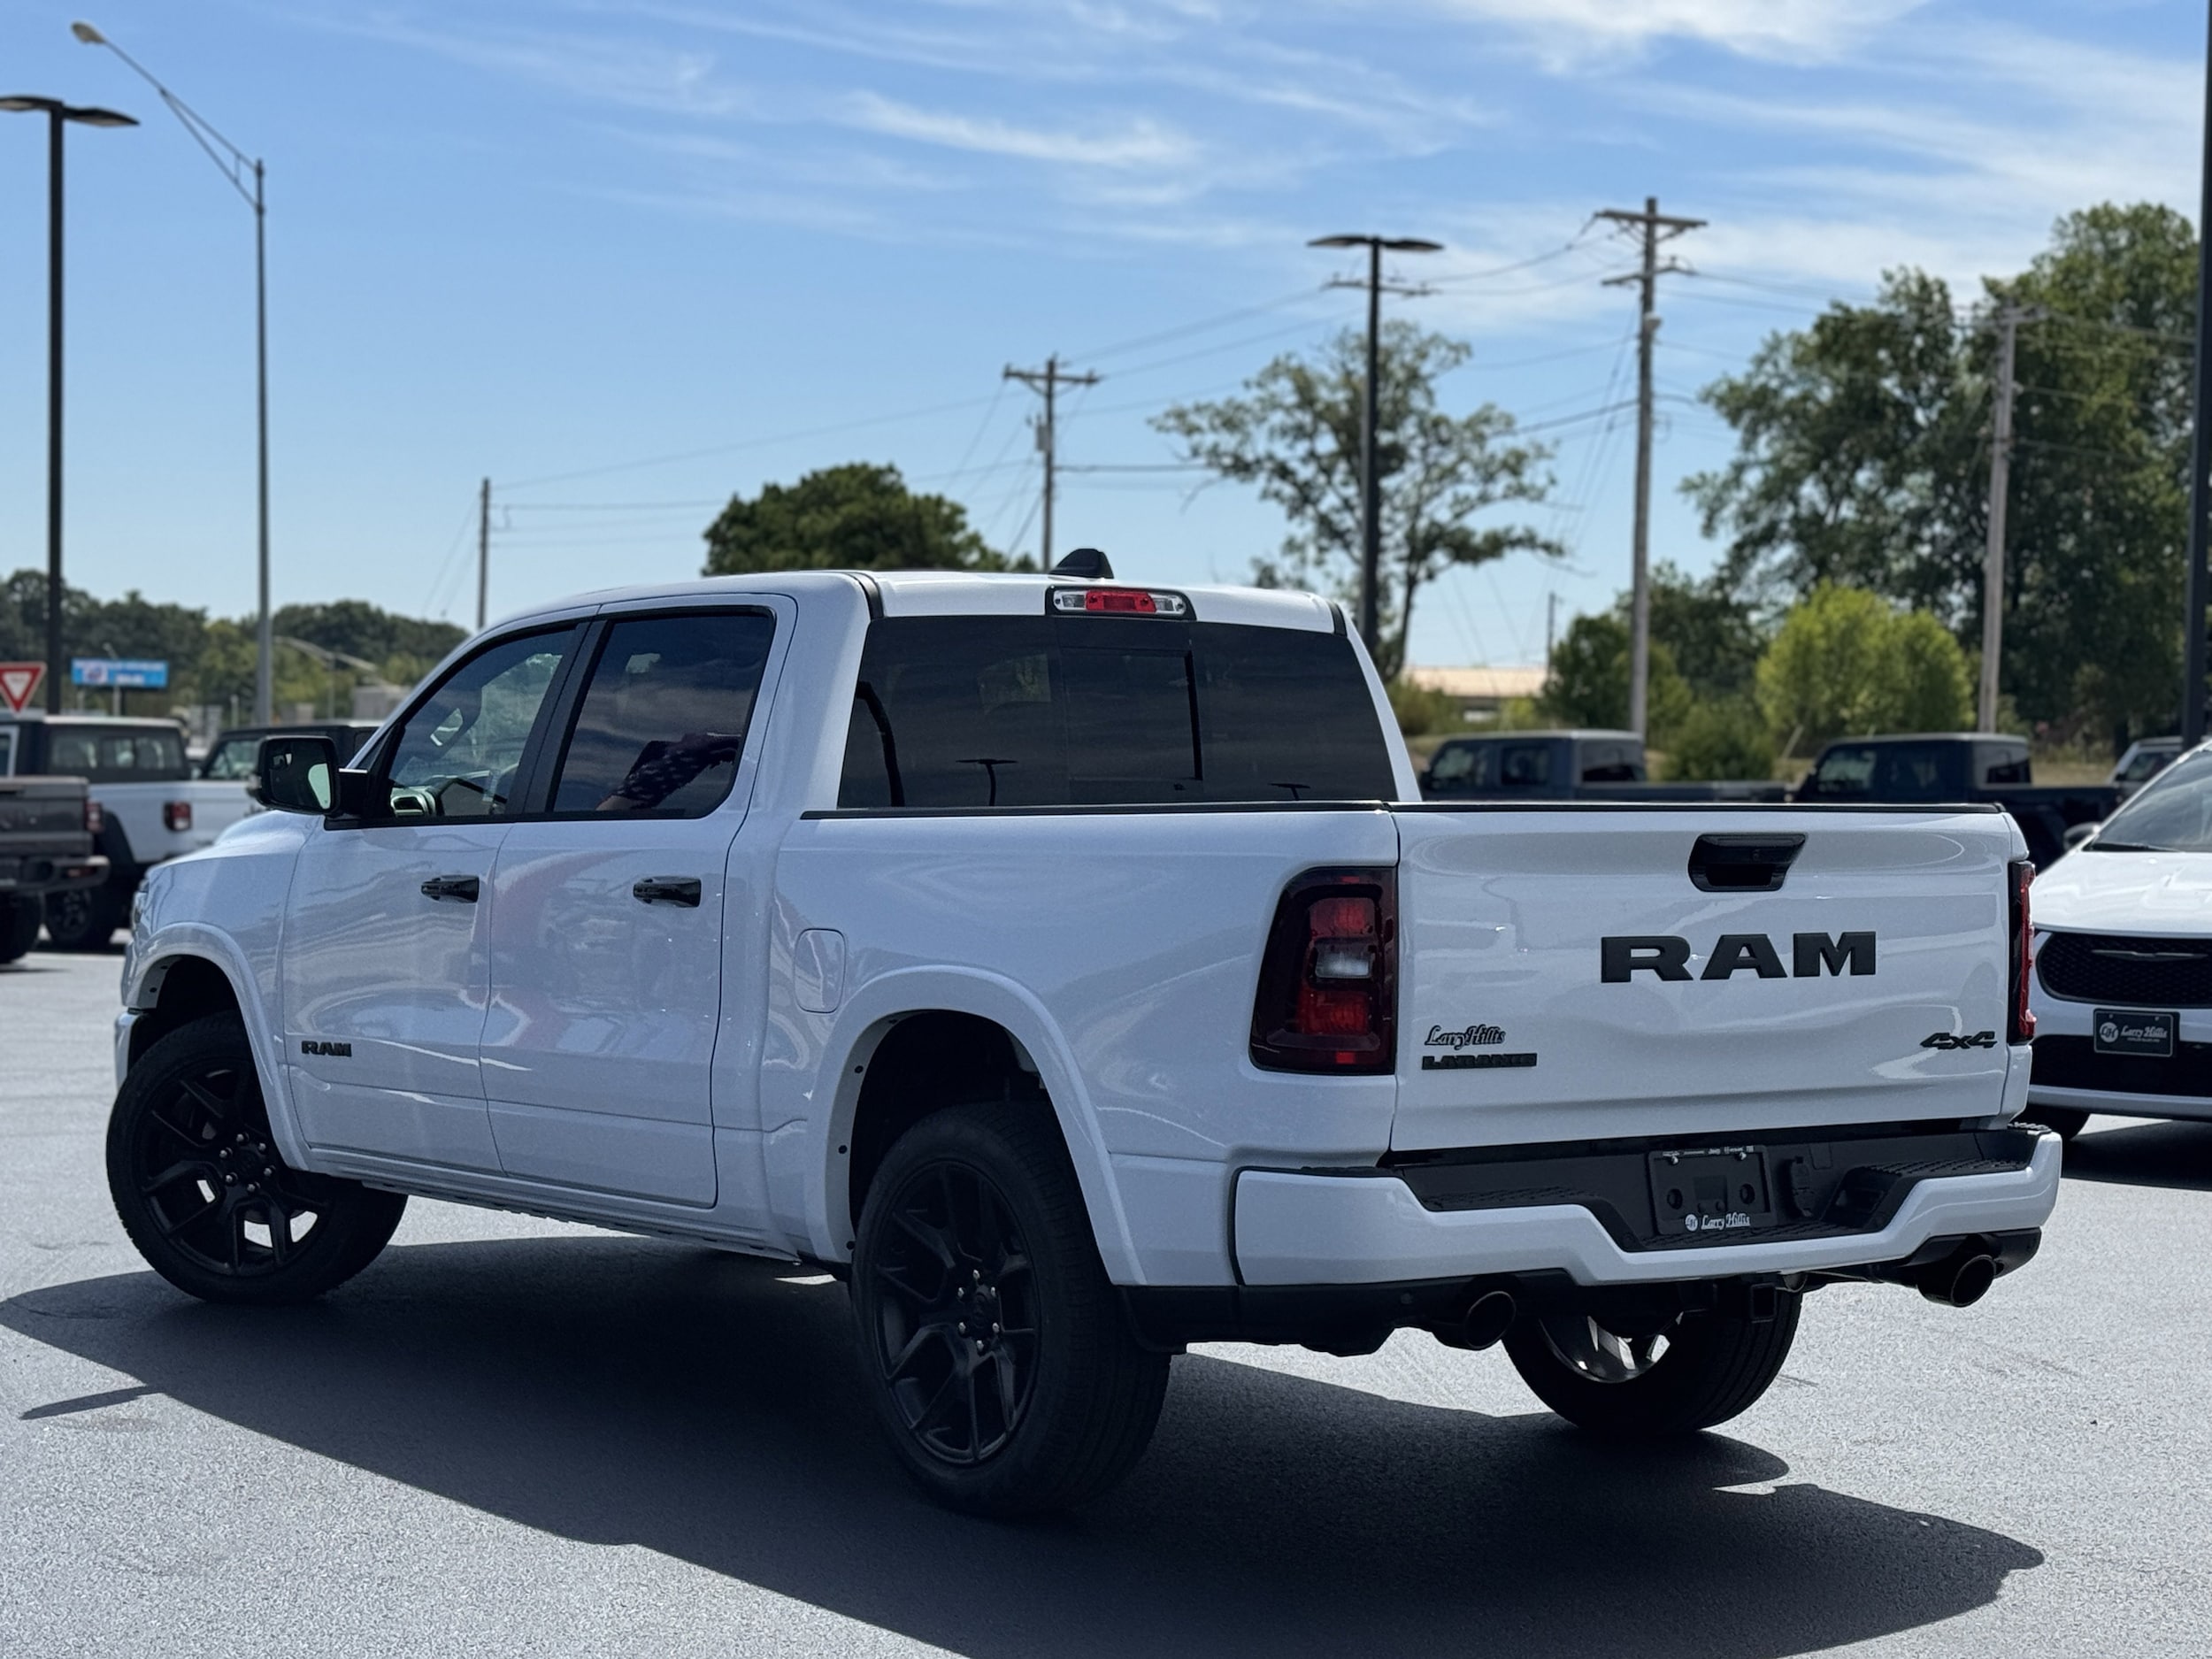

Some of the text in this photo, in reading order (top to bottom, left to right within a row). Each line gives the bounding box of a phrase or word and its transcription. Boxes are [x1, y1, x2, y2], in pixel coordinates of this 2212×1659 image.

[1601, 932, 1877, 983] RAM
[302, 1041, 352, 1057] RAM
[1919, 1031, 1998, 1050] 4x4
[1701, 1214, 1725, 1231] Larry
[1725, 1211, 1751, 1228] Hillis
